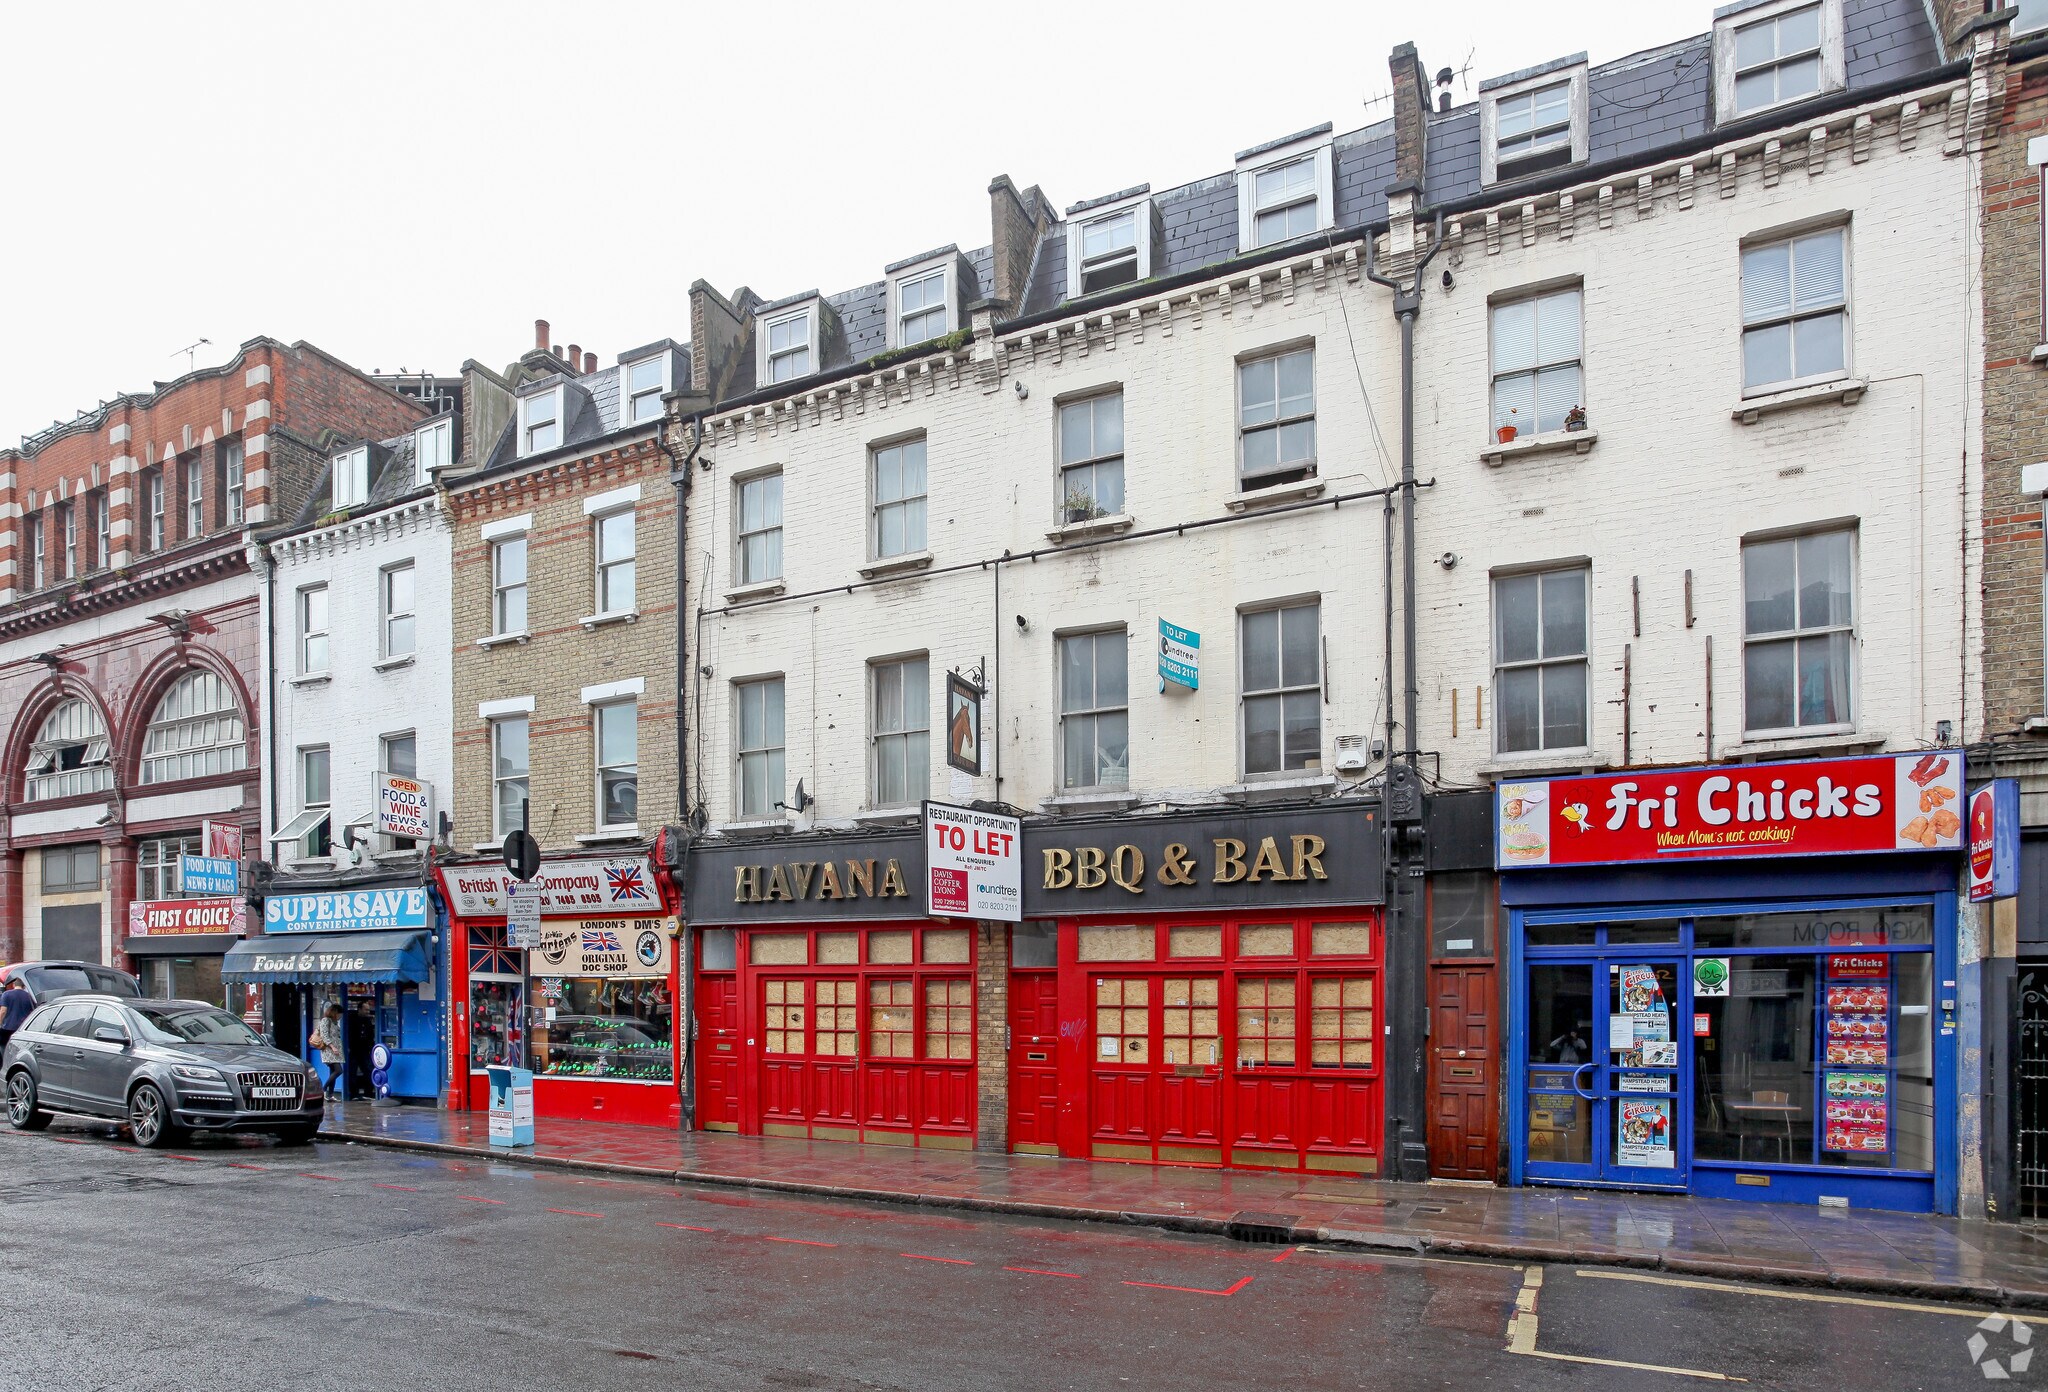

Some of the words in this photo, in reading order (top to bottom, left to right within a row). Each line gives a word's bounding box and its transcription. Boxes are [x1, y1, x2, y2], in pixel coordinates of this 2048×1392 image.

[1166, 626, 1174, 636] TO
[1175, 629, 1187, 641] LET
[1182, 667, 1197, 680] 2111
[390, 779, 417, 792] OPEN
[382, 789, 416, 805] FOOD
[420, 796, 427, 807] &
[1606, 781, 1679, 831] Fri
[1697, 775, 1883, 826] Chicks
[390, 802, 421, 818] WINE
[381, 813, 417, 826] NEWS
[421, 820, 429, 828] &
[929, 807, 973, 825] RESTAURANT
[974, 815, 1017, 832] OPPORTUNITY
[224, 825, 240, 833] CHOICE
[388, 823, 423, 835] MAGS
[1657, 831, 1686, 847] When
[1687, 829, 1724, 845] Mom's
[1726, 828, 1745, 843] not
[1749, 825, 1797, 843] cooking!
[934, 823, 966, 852] TO
[973, 829, 1013, 858] LET
[1978, 839, 1993, 853] Chicks
[186, 858, 205, 873] FOOD
[206, 860, 212, 875] &
[213, 861, 232, 875] WINE
[955, 855, 966, 863] ALL
[967, 856, 995, 866] ENQUIRIES
[1042, 844, 1145, 893] BBQ
[1157, 843, 1197, 886] &
[1212, 835, 1328, 883] BAR
[734, 858, 910, 903] HAVANA
[933, 869, 953, 879] DAVIS
[186, 876, 207, 890] NEWS
[208, 877, 214, 890] &
[215, 879, 235, 892] MAGS
[458, 877, 498, 894] British
[536, 874, 599, 892] Company
[933, 877, 962, 890] COFFER
[934, 886, 956, 895] LYONS
[976, 884, 1017, 897] roundtree
[266, 889, 425, 923] SUPERSAVE
[978, 901, 988, 909] 020
[989, 902, 1004, 910] 8203
[1005, 903, 1017, 912] 2111
[148, 909, 182, 928] FIRST
[185, 907, 229, 927] CHOICE
[287, 918, 356, 931] CONVENIENT
[360, 917, 397, 927] STORE
[580, 920, 626, 930] LONDON'S
[634, 920, 661, 930] DM'S
[540, 932, 577, 949] artens
[252, 955, 296, 971] Food
[298, 955, 316, 971] &
[319, 954, 364, 971] Wine
[582, 953, 628, 963] ORIGINAL
[1833, 958, 1848, 968] Fri
[1851, 957, 1883, 968] Chicks
[582, 963, 601, 972] DOC
[603, 963, 628, 971] SHOP
[1624, 972, 1656, 988] CIRCUS
[1623, 1105, 1654, 1120] CIRCUS
